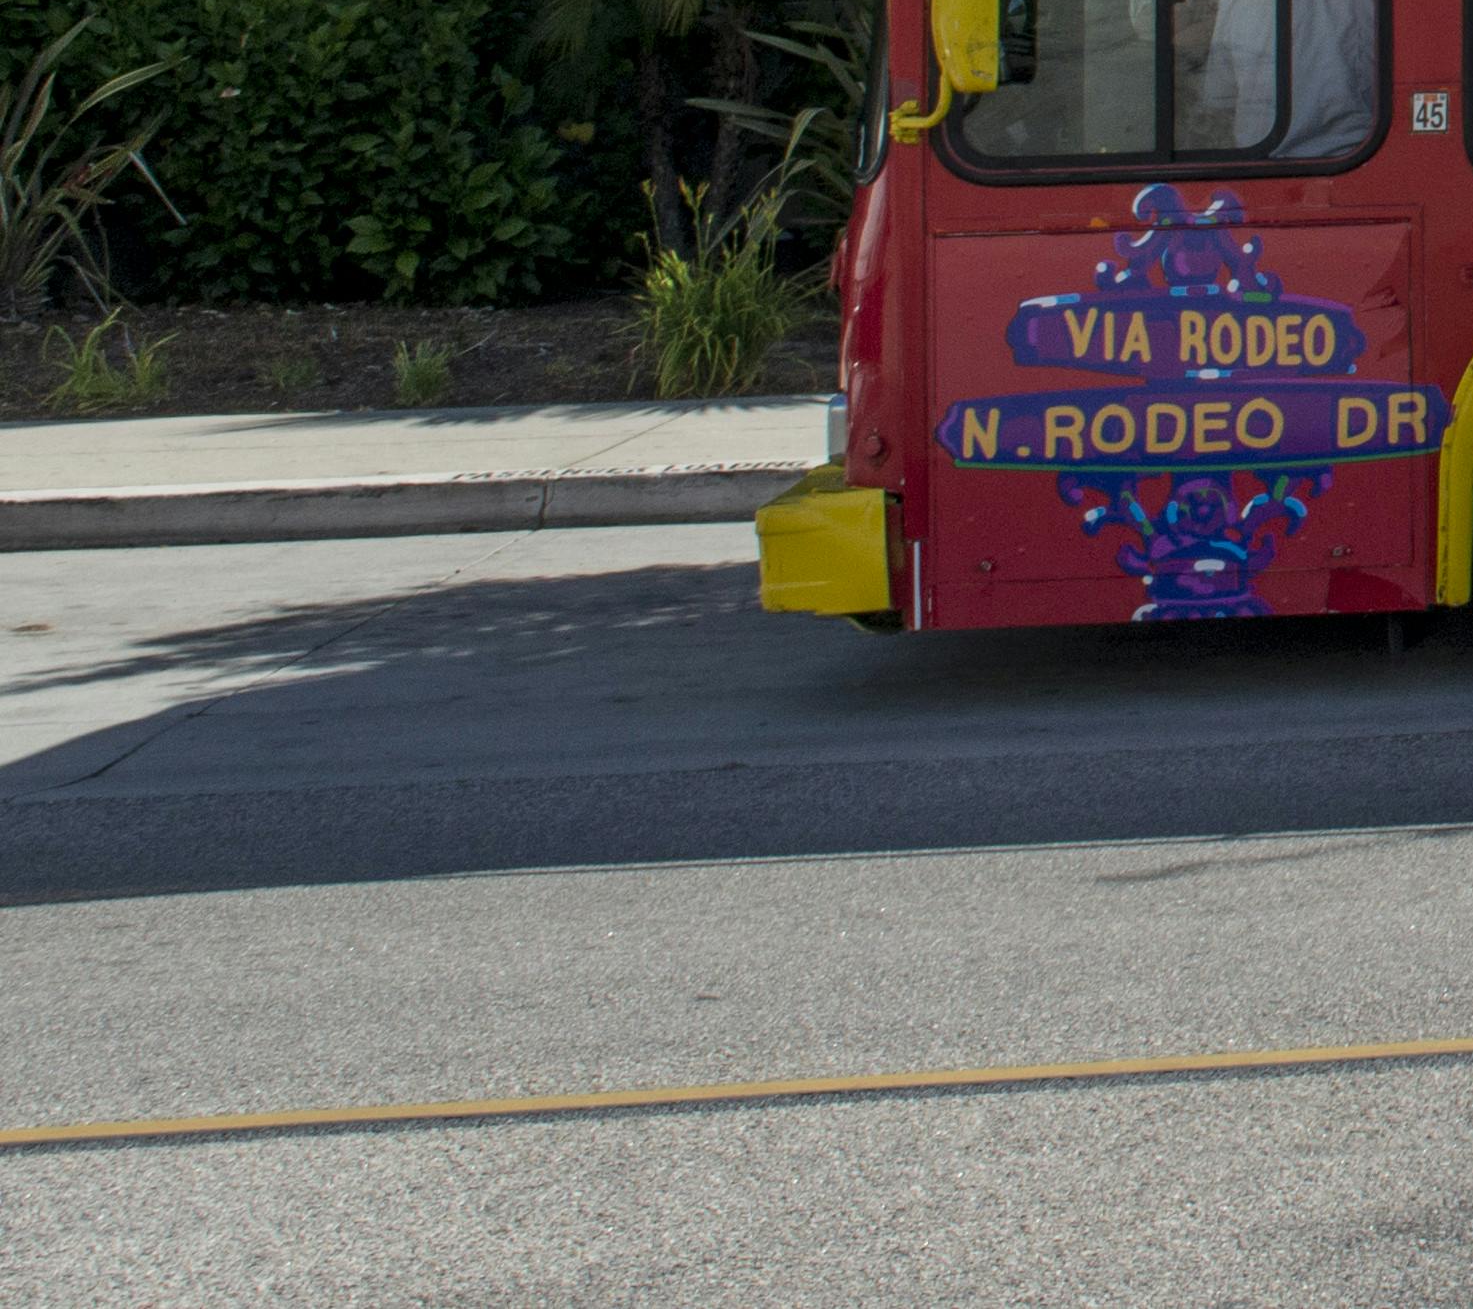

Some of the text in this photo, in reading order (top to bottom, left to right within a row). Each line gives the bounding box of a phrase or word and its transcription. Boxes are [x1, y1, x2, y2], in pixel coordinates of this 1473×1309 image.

[1416, 102, 1444, 129] 45
[1063, 308, 1337, 367] VIA RODEO
[1337, 393, 1427, 448] DR
